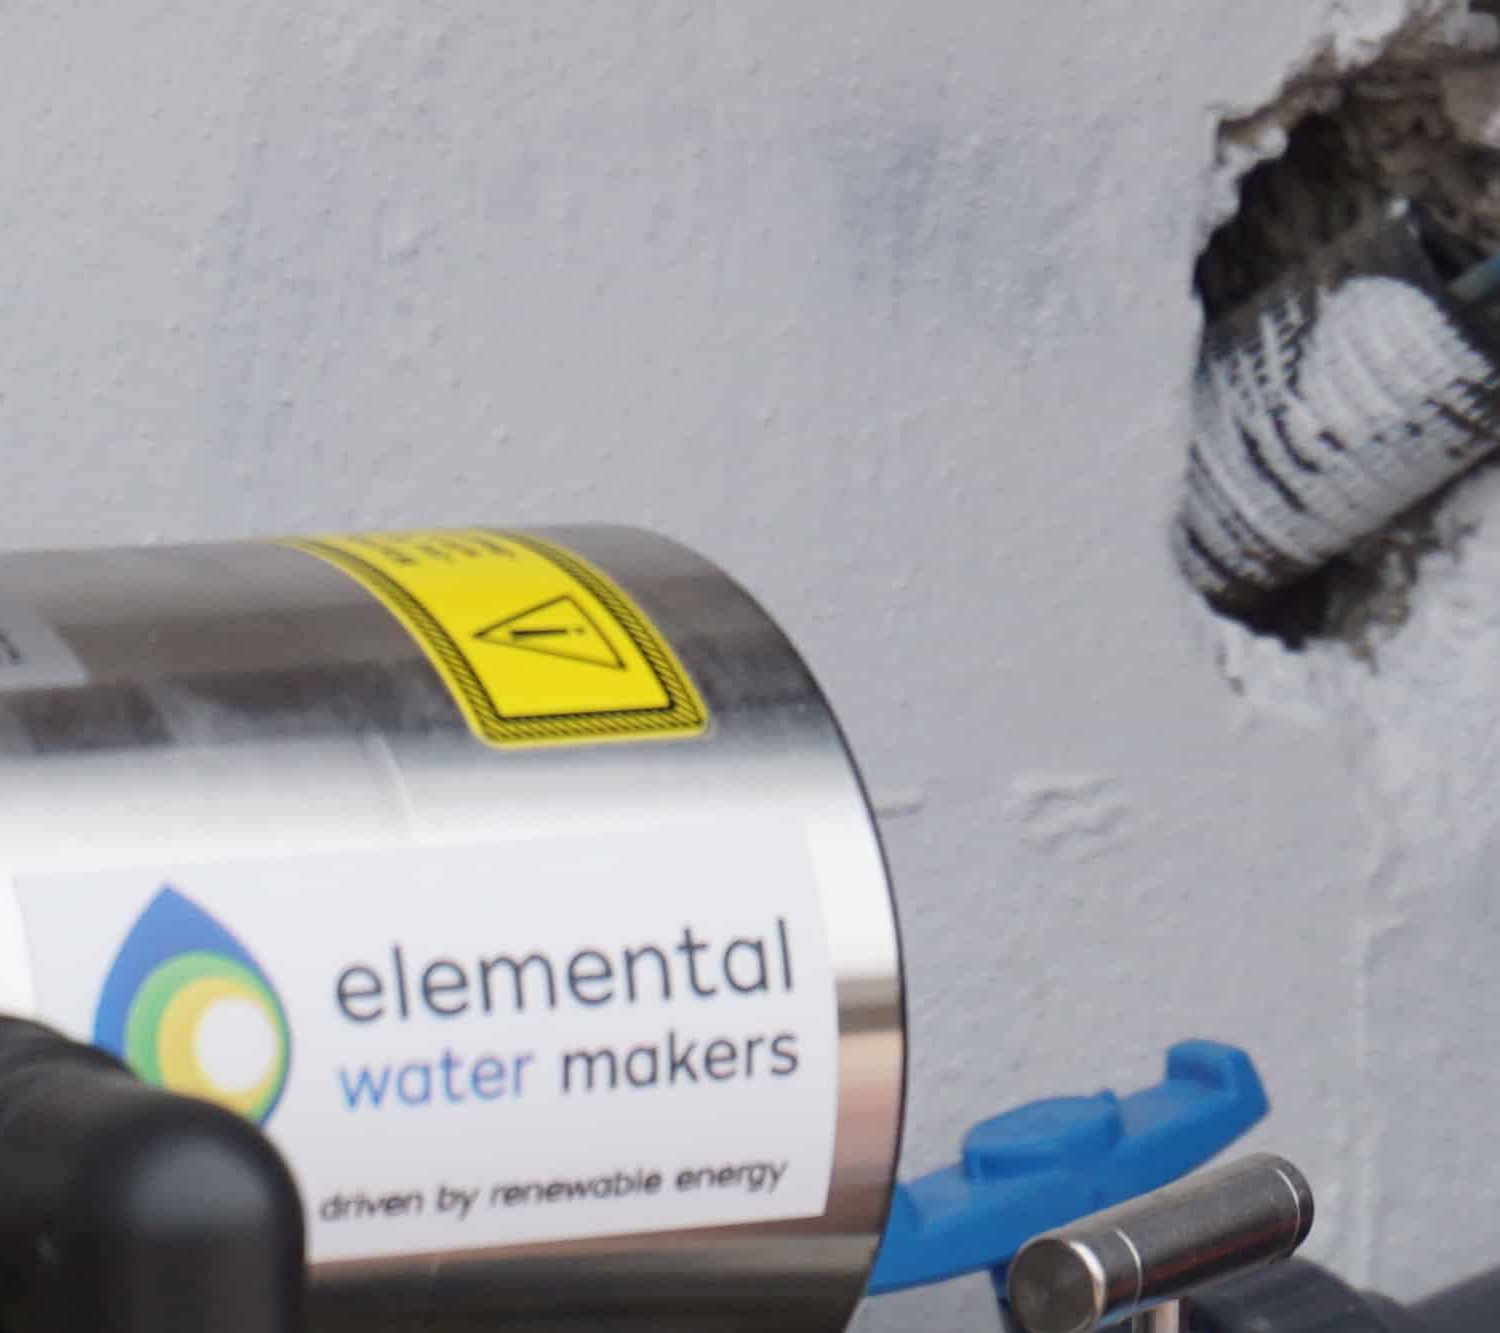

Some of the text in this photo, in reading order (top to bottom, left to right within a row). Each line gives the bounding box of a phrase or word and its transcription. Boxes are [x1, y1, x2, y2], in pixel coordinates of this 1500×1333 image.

[334, 916, 794, 1023] elemental
[337, 1028, 799, 1112] water makers
[319, 1159, 788, 1223] driven by renewable energy
